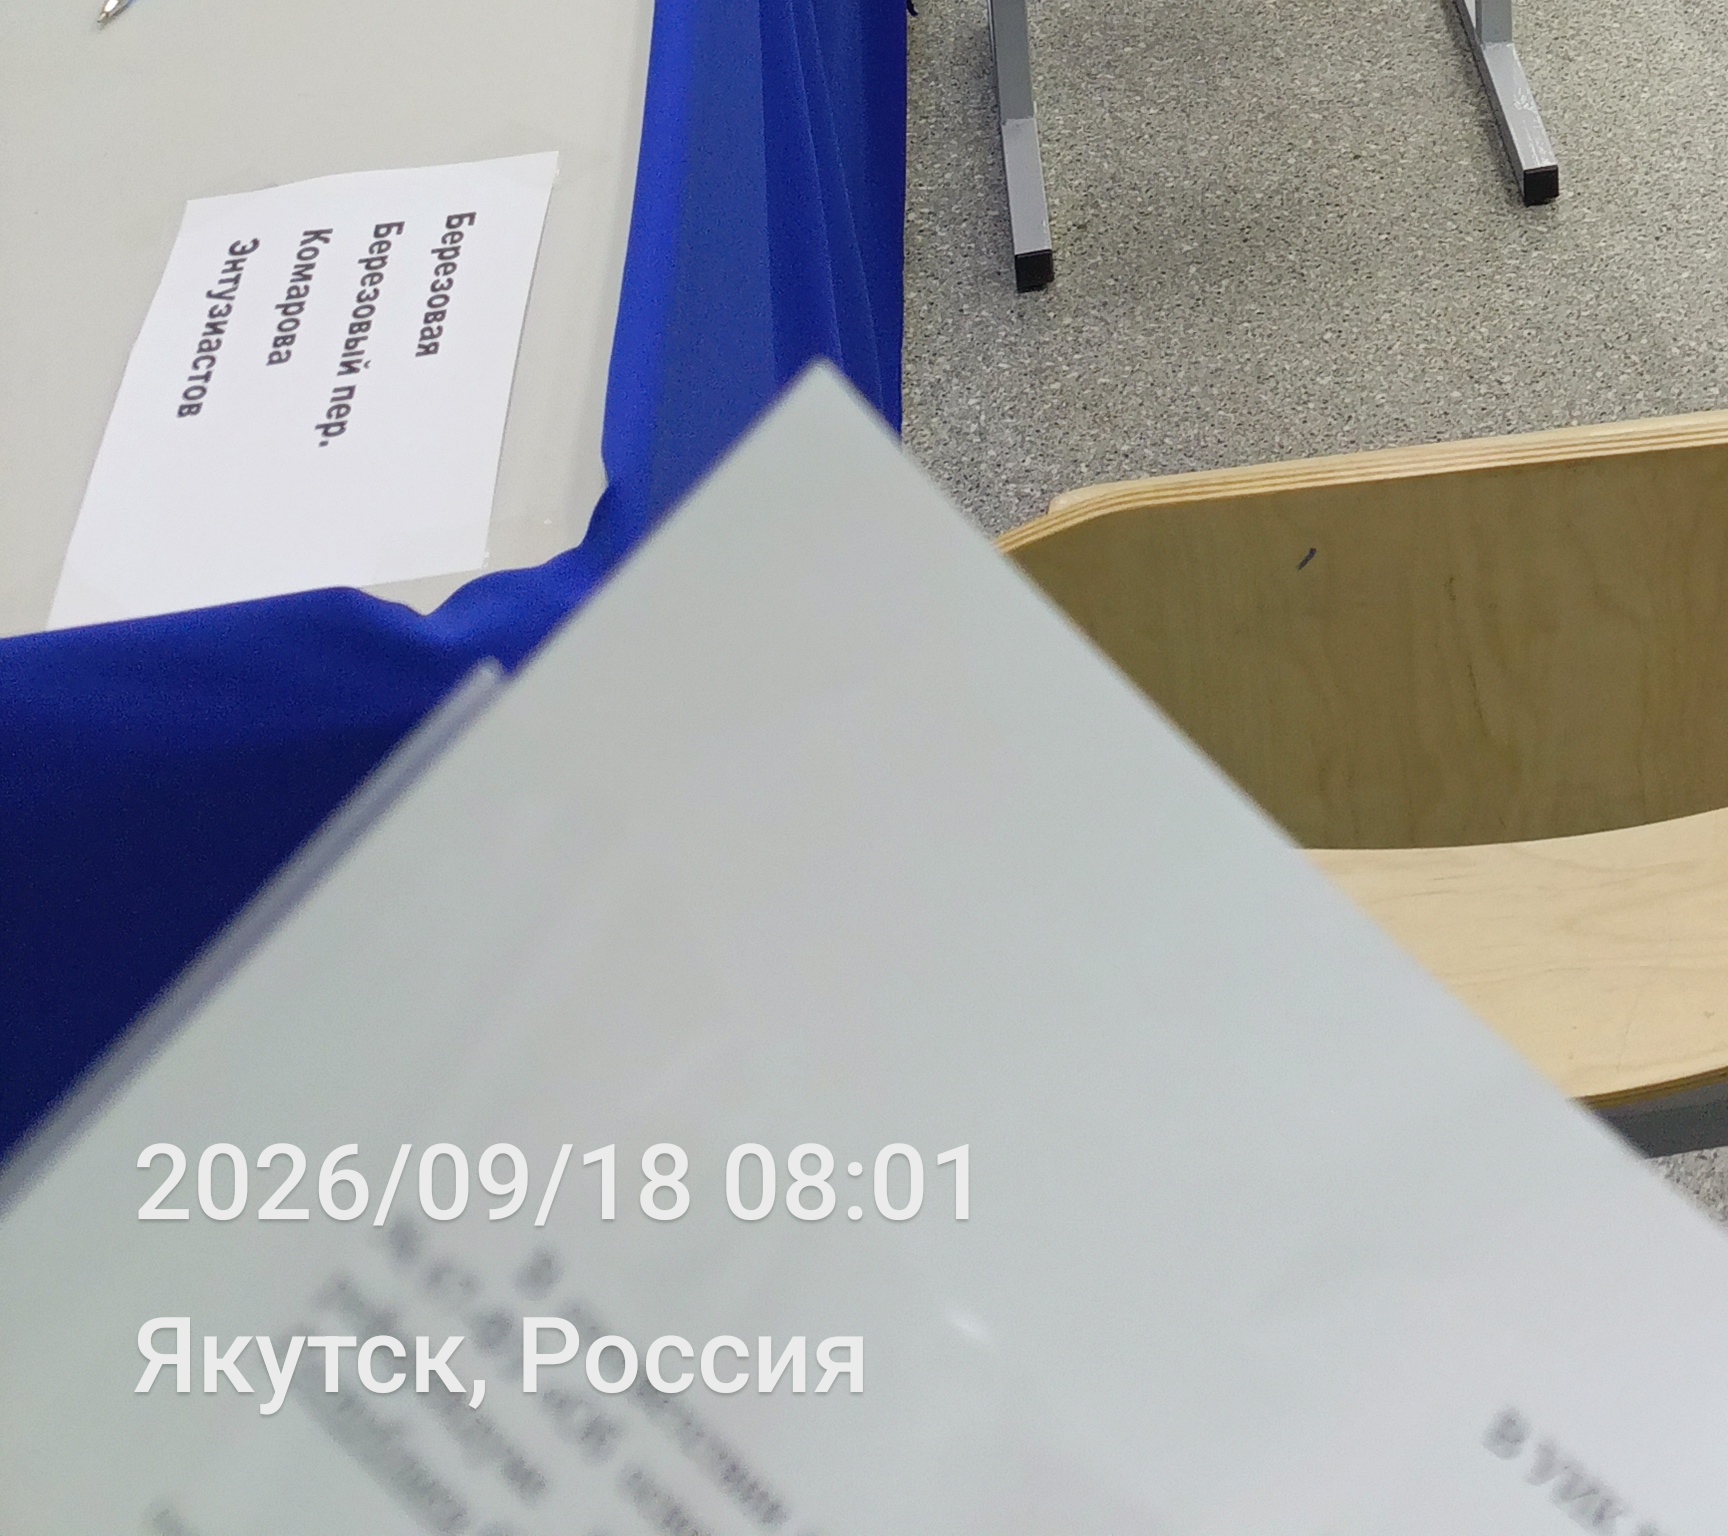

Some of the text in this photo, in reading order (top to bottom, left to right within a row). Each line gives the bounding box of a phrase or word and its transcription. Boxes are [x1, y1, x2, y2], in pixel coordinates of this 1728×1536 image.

[177, 238, 260, 418] Энтузиастов
[267, 228, 333, 366] Комарова
[315, 220, 405, 448] Березовый пер.
[415, 211, 477, 357] Березовая
